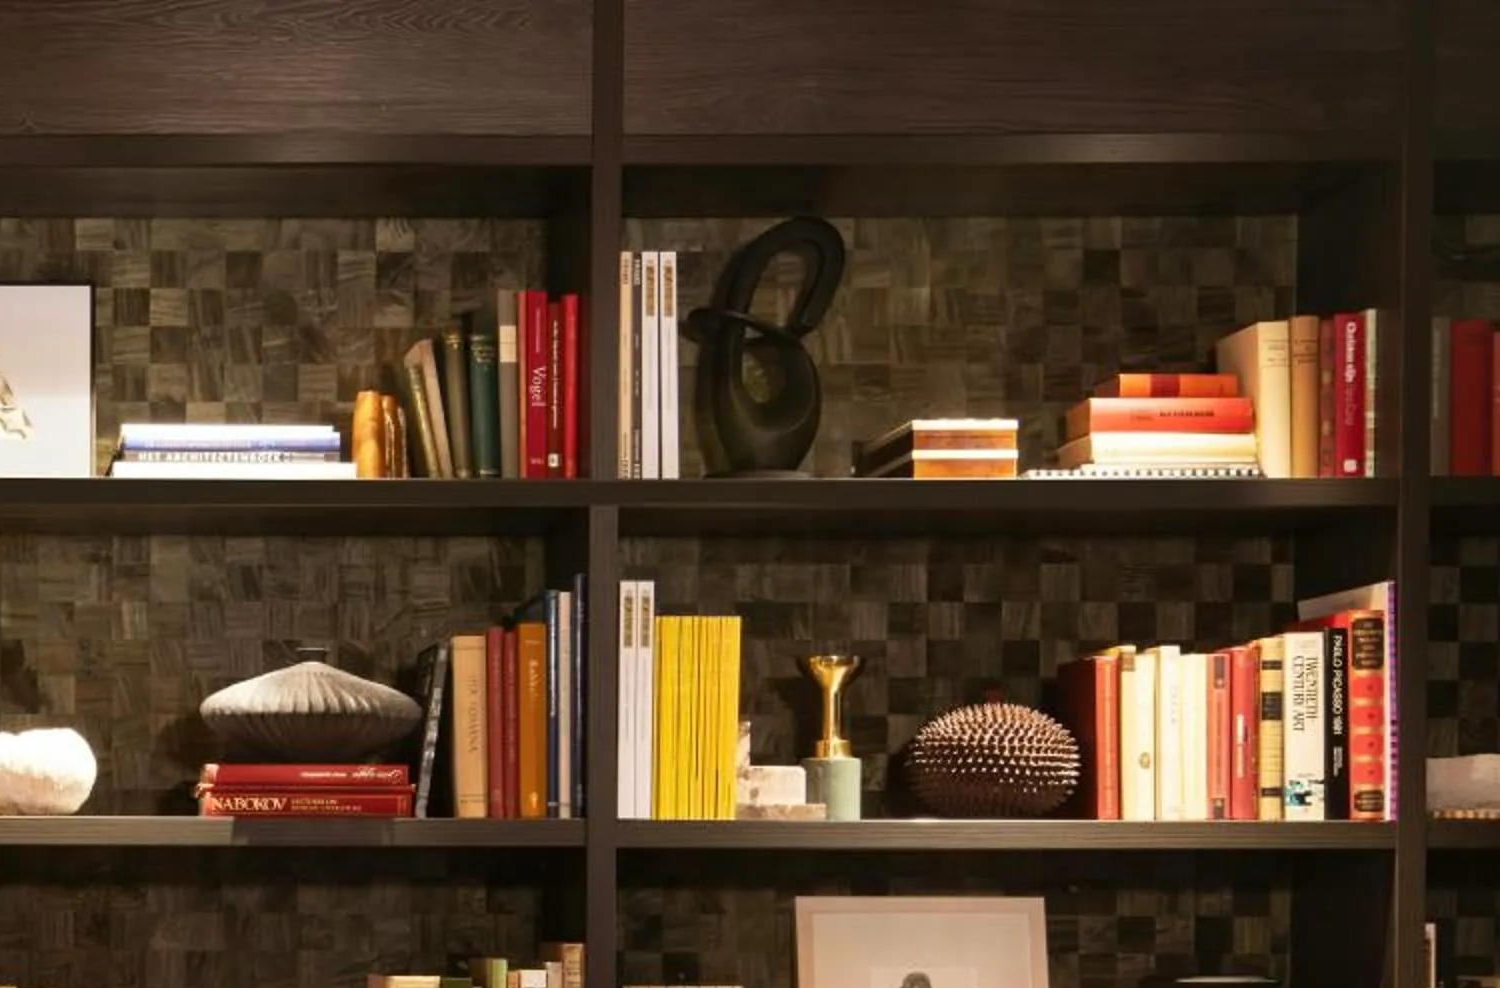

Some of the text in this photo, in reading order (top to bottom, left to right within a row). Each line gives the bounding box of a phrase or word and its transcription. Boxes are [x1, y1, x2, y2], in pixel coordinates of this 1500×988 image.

[530, 366, 546, 408] Vogel
[1333, 635, 1343, 668] PABLO
[1293, 655, 1304, 732] CENTURY ART
[1306, 657, 1319, 719] TWENTIETH
[1332, 669, 1343, 714] PICASSO
[211, 797, 287, 812] NABOKOV
